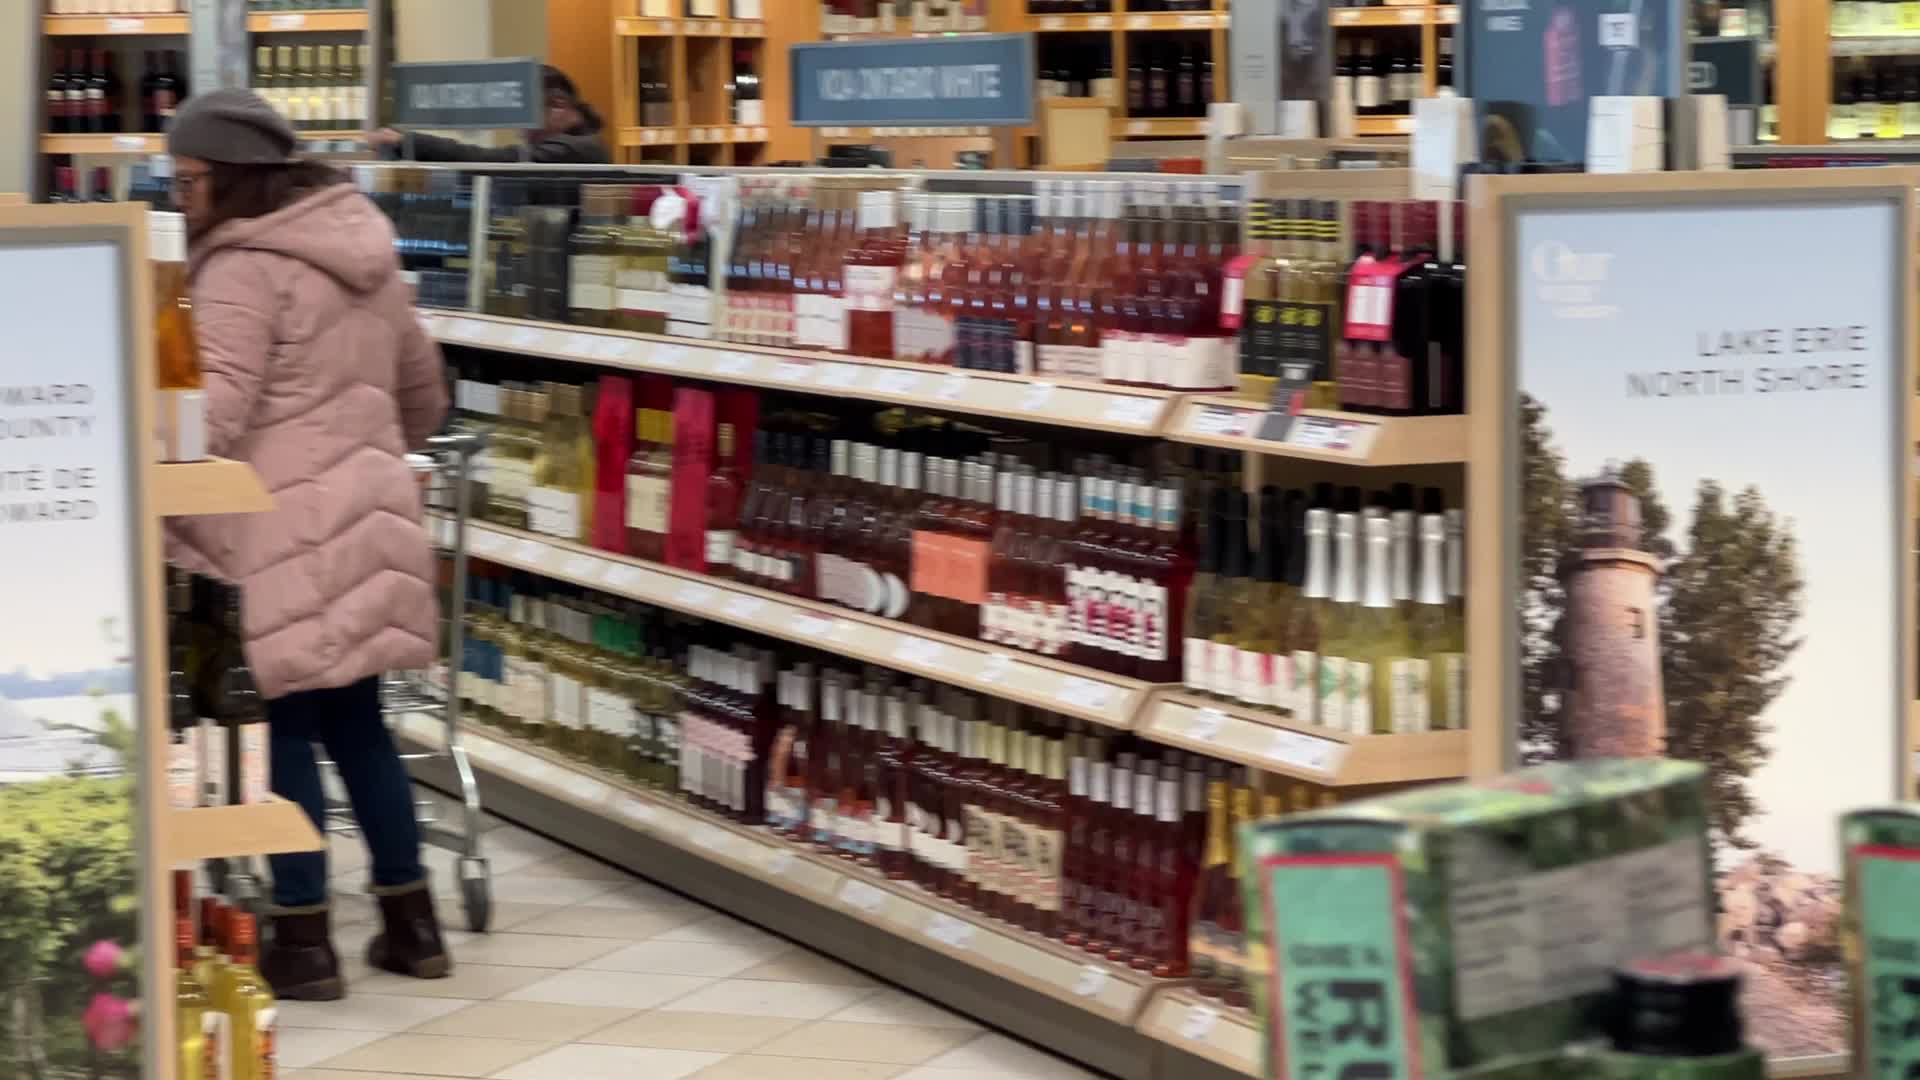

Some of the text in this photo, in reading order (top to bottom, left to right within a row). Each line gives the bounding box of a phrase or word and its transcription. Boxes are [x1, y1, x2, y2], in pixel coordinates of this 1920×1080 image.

[1697, 325, 1866, 357] LAKE ERIE
[1626, 362, 1867, 398] NORTH SHORE
[54, 467, 95, 489] DE
